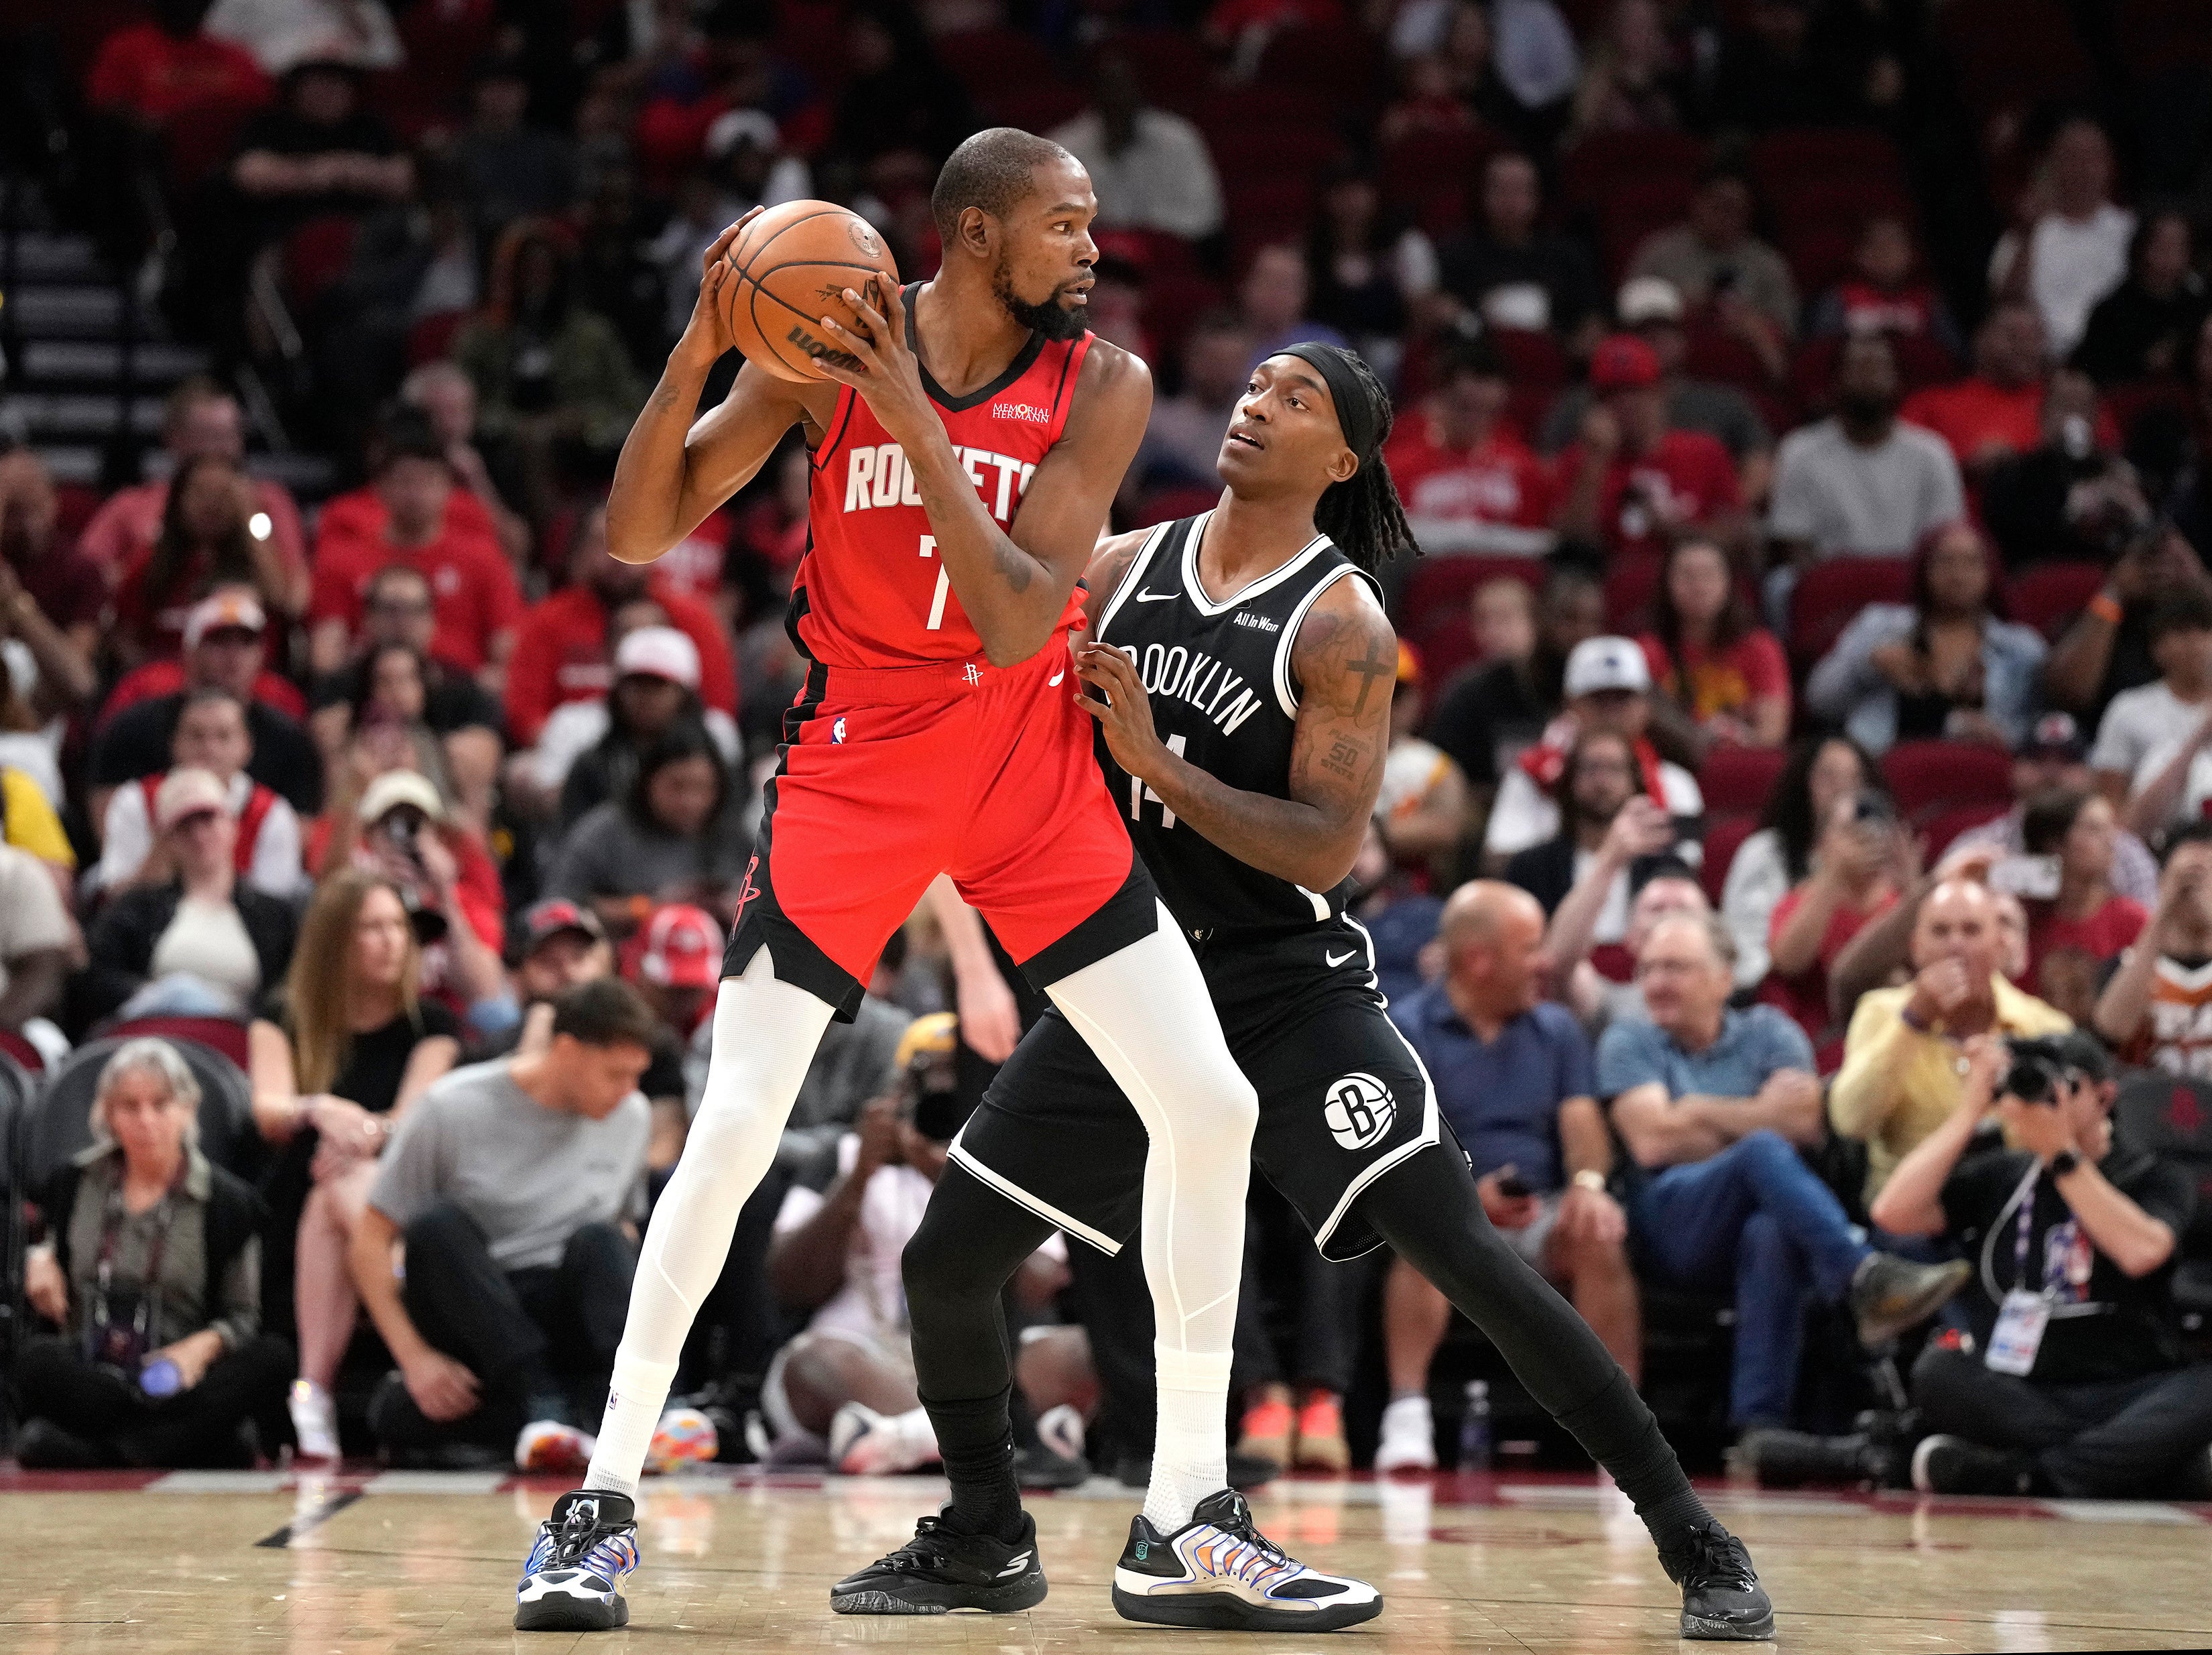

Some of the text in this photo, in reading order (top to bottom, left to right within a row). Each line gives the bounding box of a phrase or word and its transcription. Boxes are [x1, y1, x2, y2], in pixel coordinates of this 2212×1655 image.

[992, 409, 1050, 424] HERMANN
[993, 403, 1050, 417] MEMORIAL
[843, 442, 1038, 522] ROCET
[1233, 611, 1280, 632] All In Won
[1117, 643, 1262, 737] OOKLYN
